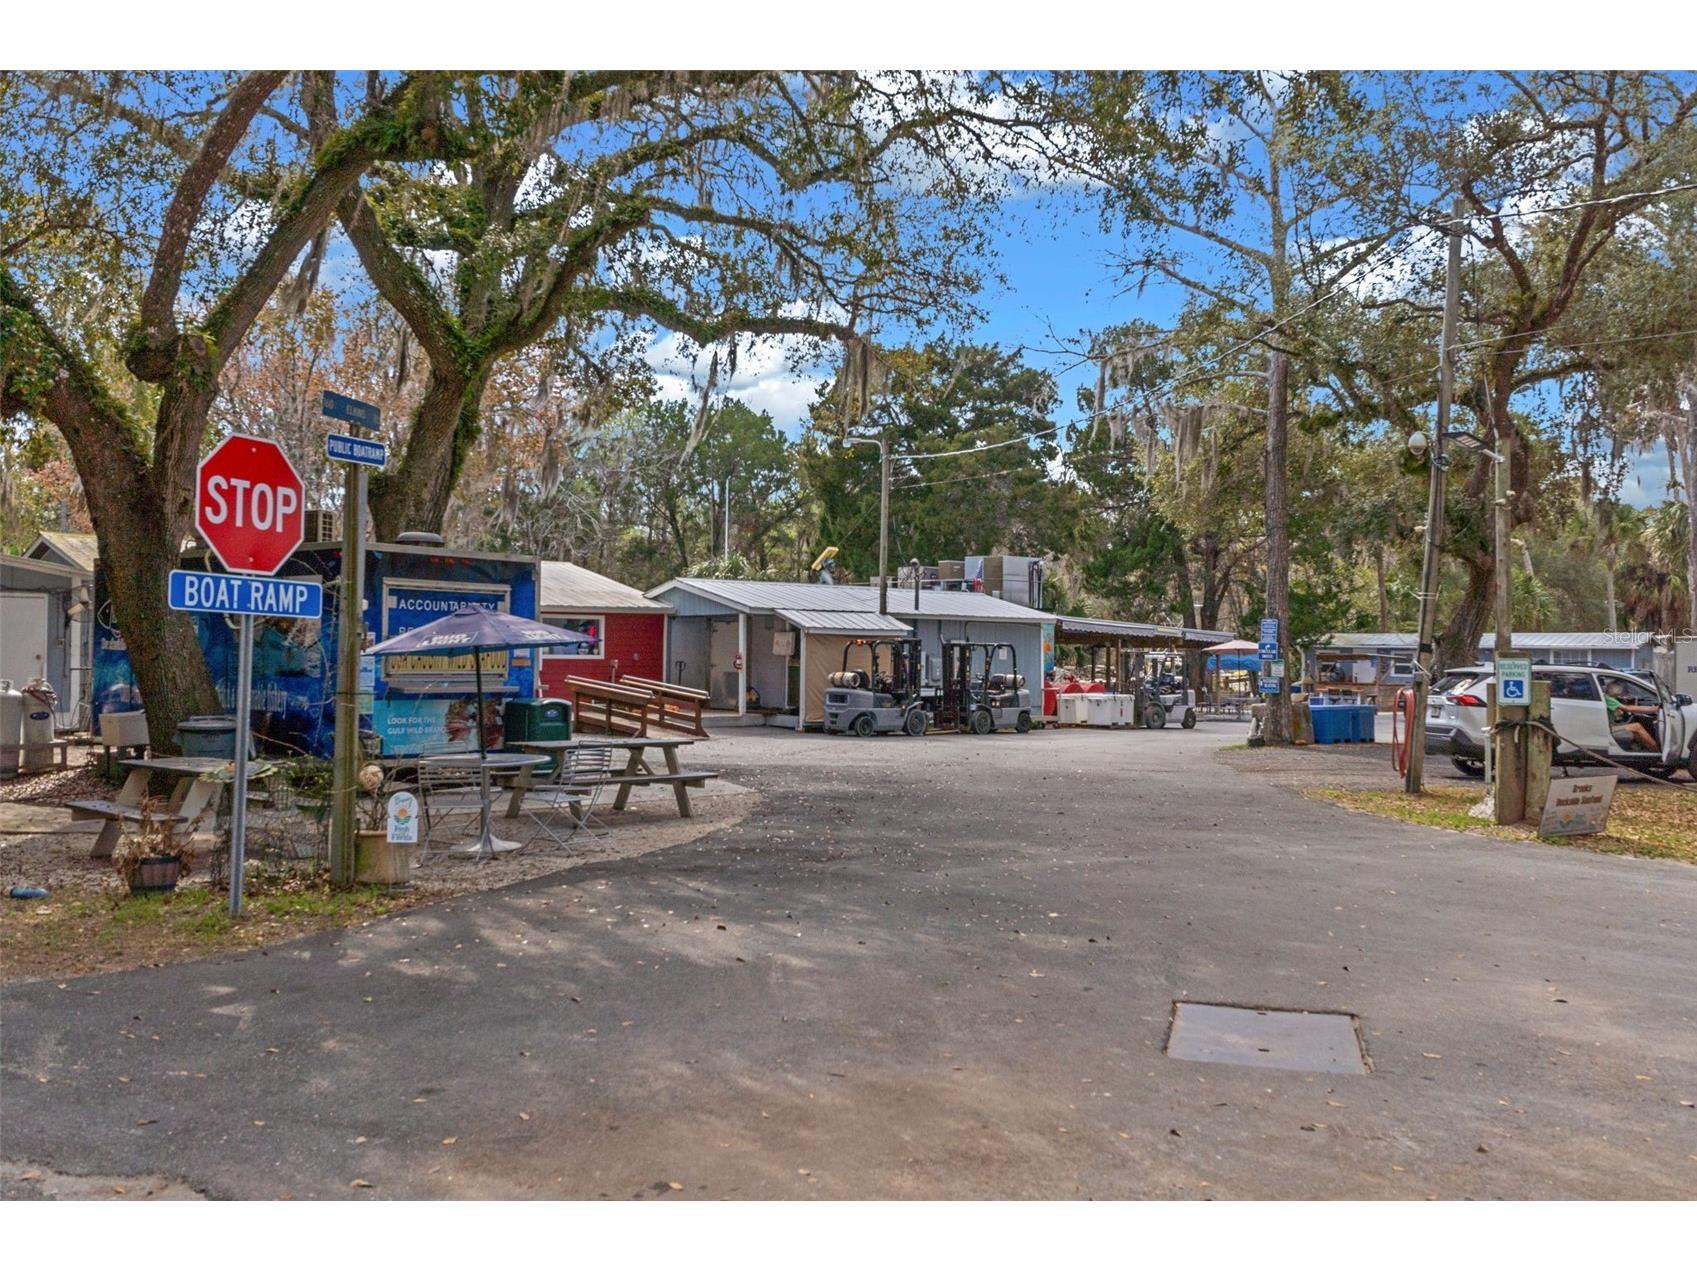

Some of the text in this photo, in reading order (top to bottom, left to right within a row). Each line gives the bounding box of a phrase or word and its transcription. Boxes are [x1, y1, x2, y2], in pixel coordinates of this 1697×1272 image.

[330, 439, 385, 461] PUBLIC BOATRAMP
[205, 475, 298, 533] STOP
[184, 575, 308, 614] BOAT RAMP
[387, 715, 408, 725] LOOK
[409, 716, 423, 725] FOR
[387, 726, 406, 736] GULF
